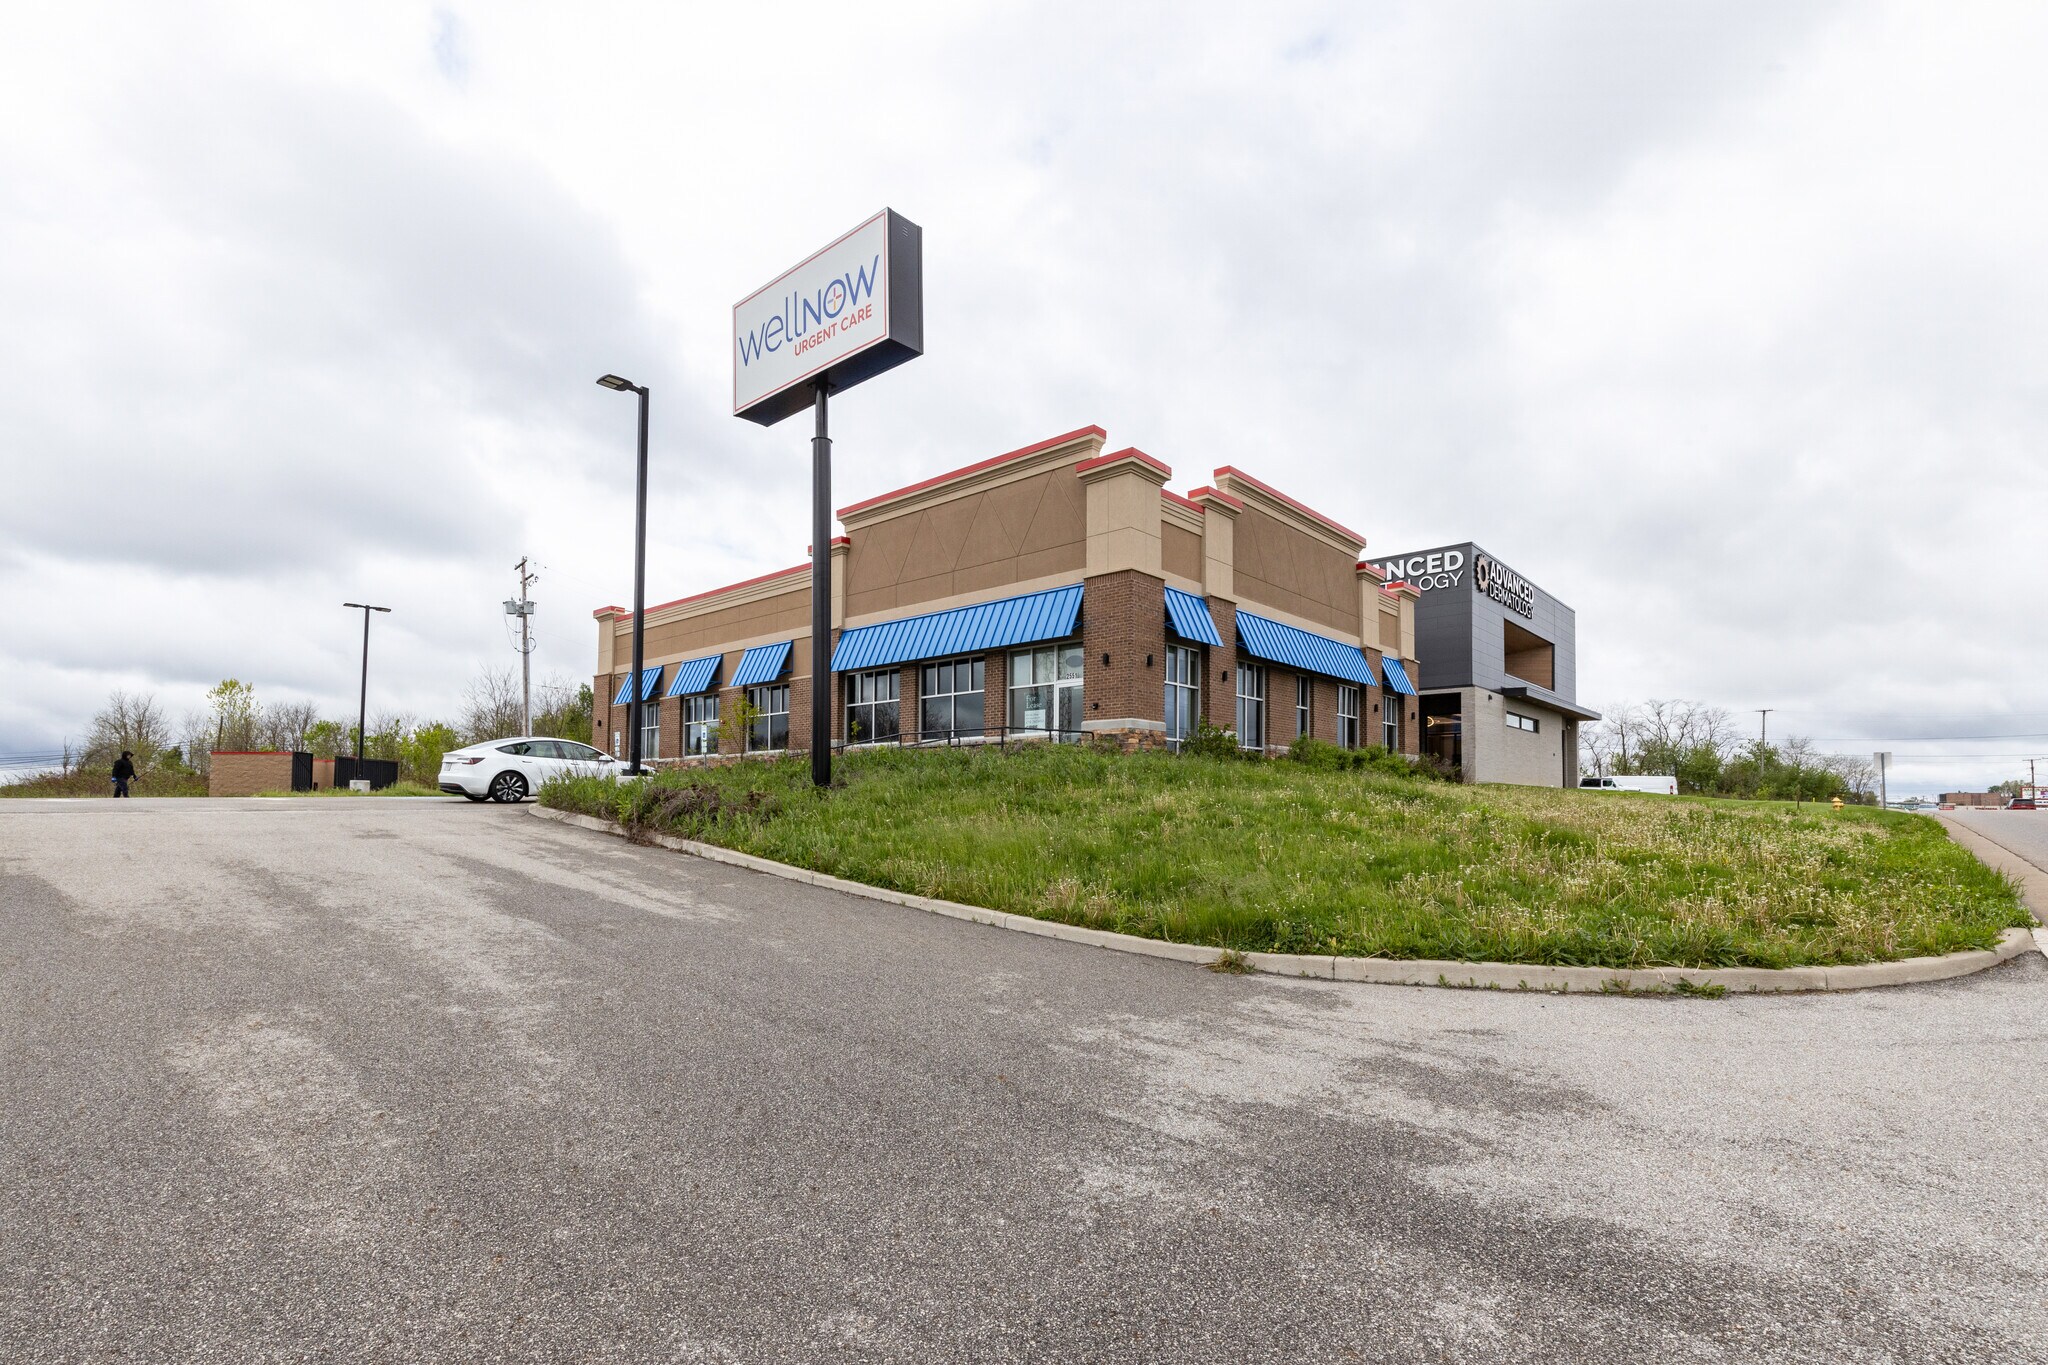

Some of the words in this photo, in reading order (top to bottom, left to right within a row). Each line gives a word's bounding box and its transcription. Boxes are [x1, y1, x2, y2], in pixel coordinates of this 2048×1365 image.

[794, 322, 838, 356] URGENT
[840, 303, 873, 331] CARE
[1372, 550, 1464, 580] NCED
[1490, 560, 1535, 604] ADVANCED
[1490, 580, 1535, 619] DERMATOLOGY
